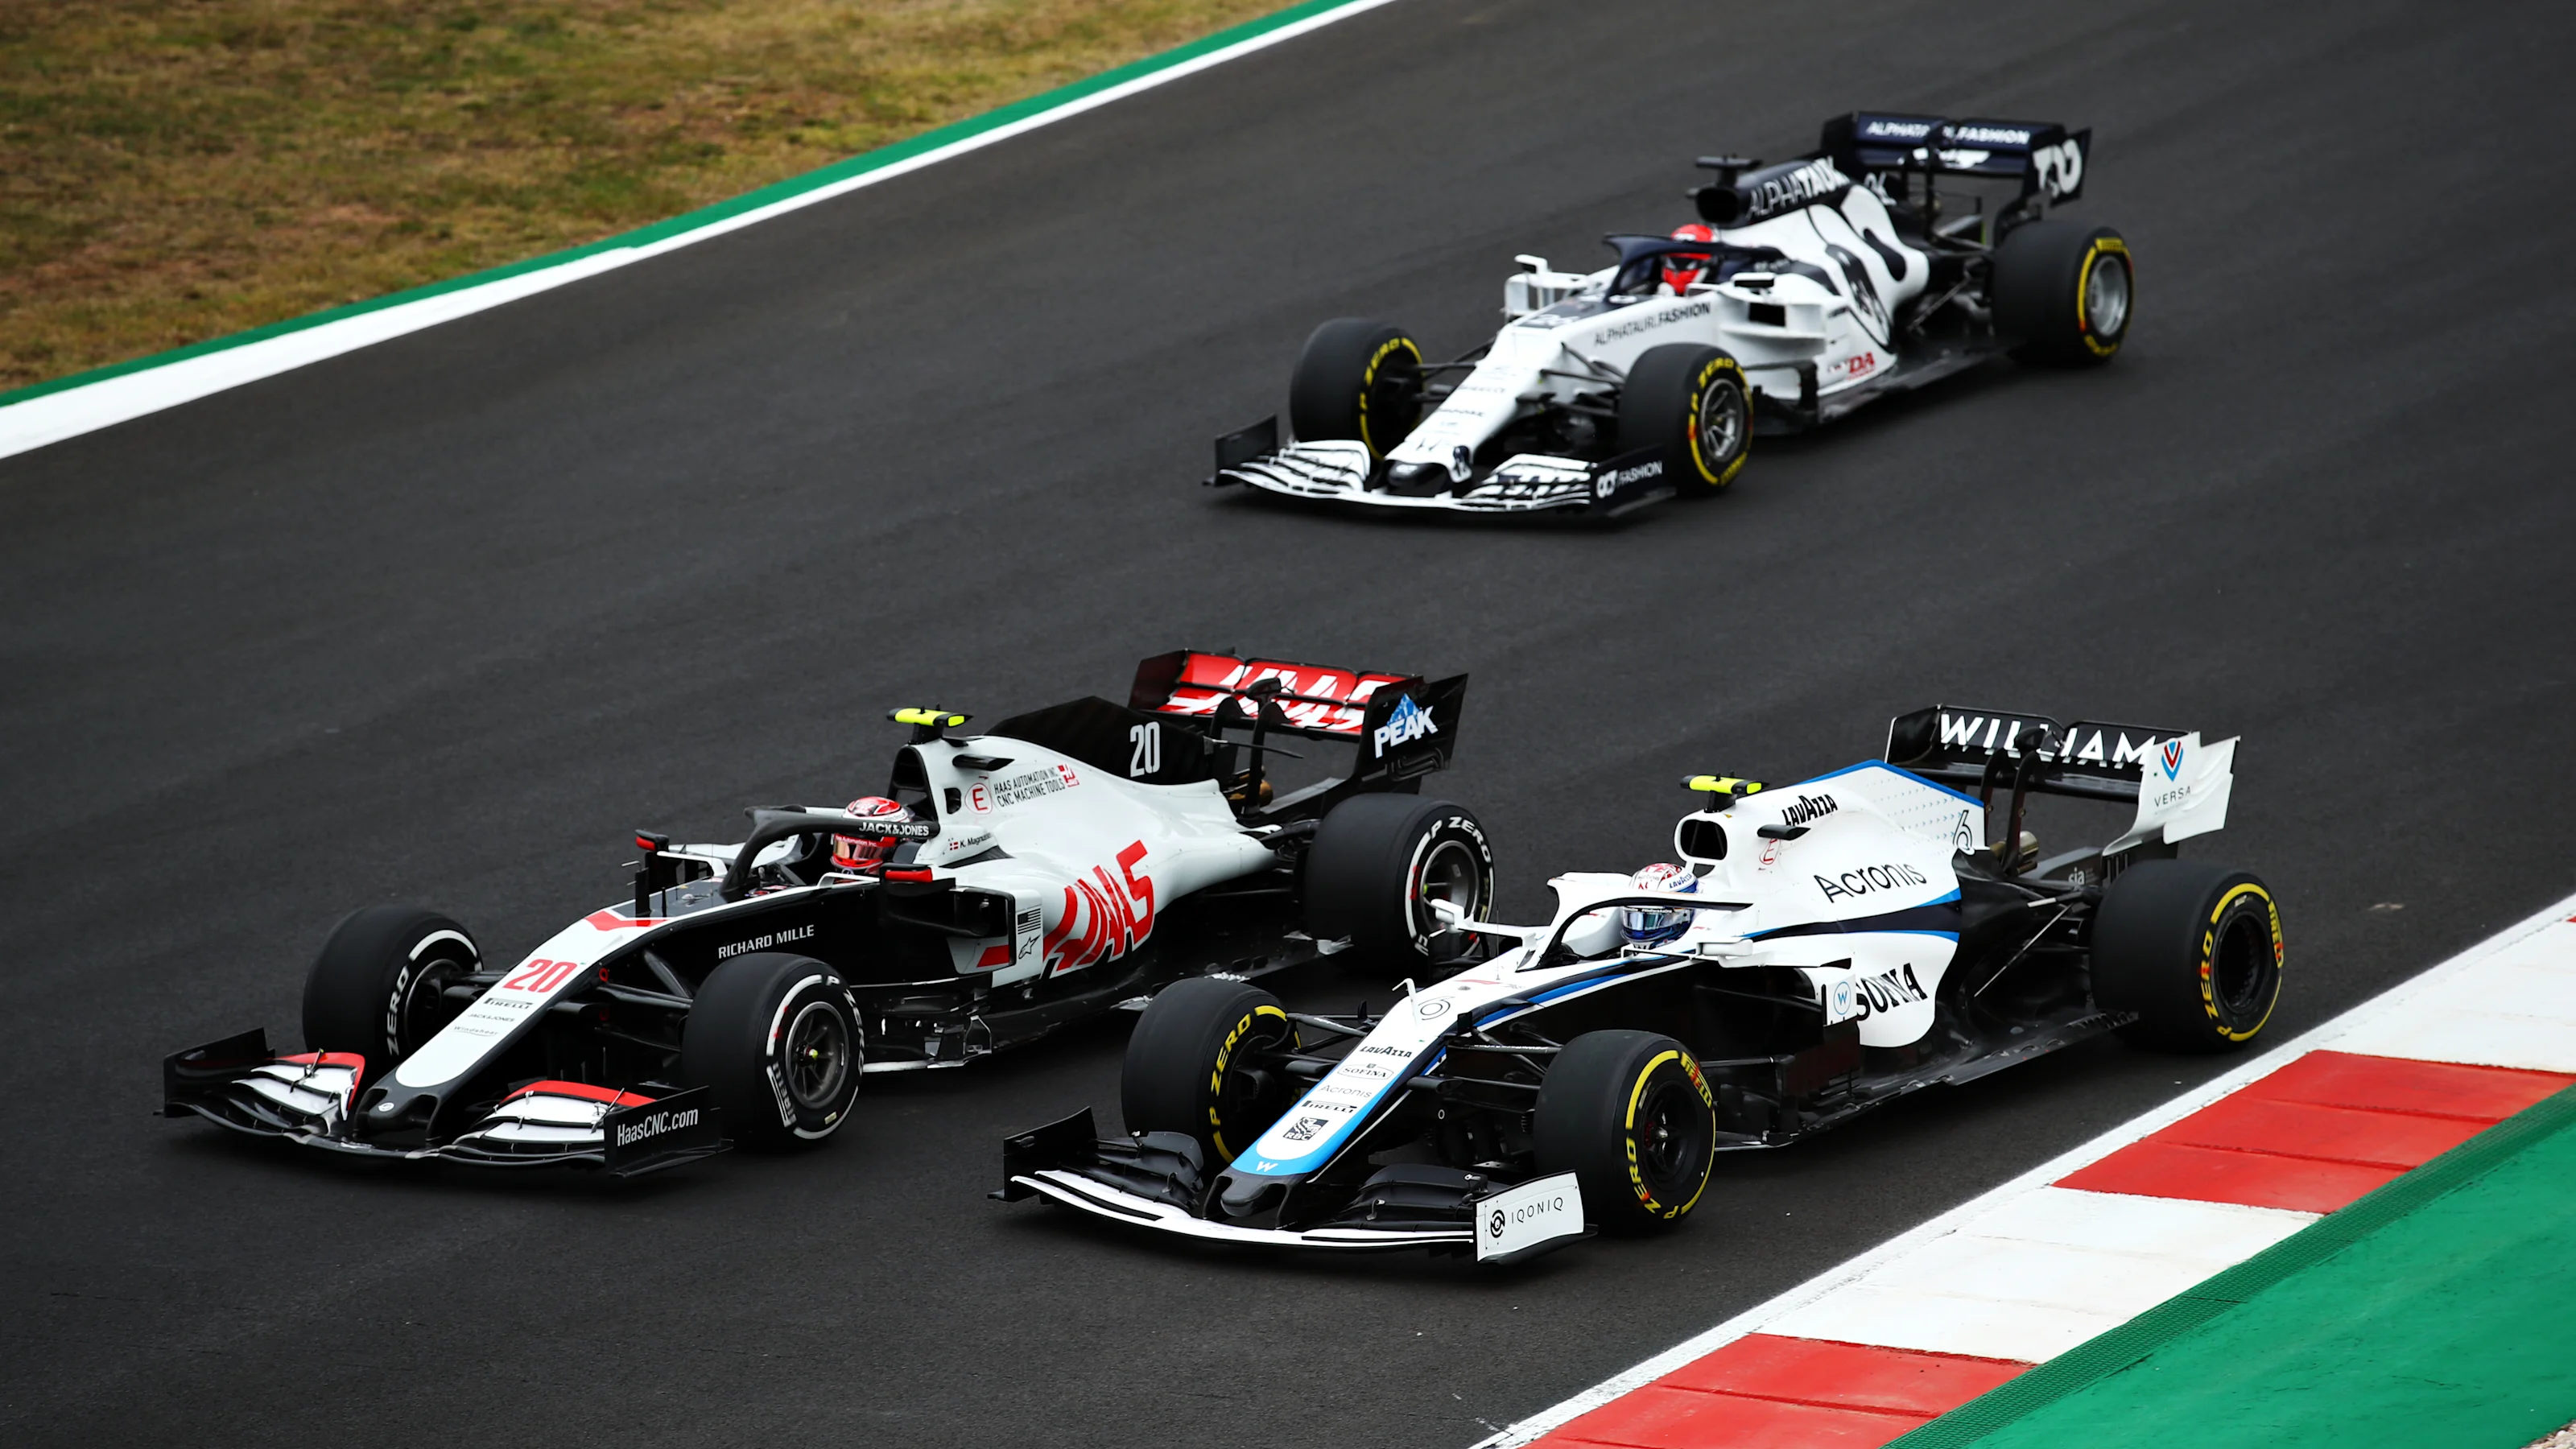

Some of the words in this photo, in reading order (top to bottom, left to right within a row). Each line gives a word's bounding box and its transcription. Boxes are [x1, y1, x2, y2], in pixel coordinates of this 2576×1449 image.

[1374, 705, 1439, 758] PEAK
[1129, 721, 1160, 777] 20
[993, 780, 1012, 795] HAAS
[1013, 770, 1049, 789] AUTOMATION
[997, 792, 1014, 807] CNC
[1013, 782, 1046, 803] MACHINE
[1045, 778, 1066, 794] TOOLS
[2154, 786, 2190, 807] VERSA
[859, 822, 930, 836] JACK&JONES
[1430, 819, 1443, 839] P
[1448, 816, 1492, 863] ZERO
[1953, 810, 1974, 855] 6
[1814, 864, 1927, 903] Acronis
[718, 935, 773, 959] RICHARD
[776, 924, 815, 944] MILLE
[502, 958, 577, 993] 20
[826, 975, 840, 986] P
[2201, 930, 2219, 1020] ZERO
[387, 965, 409, 1056] ZERO
[484, 997, 533, 1009] PIRELLI
[1211, 1013, 1251, 1097] ZERO
[1342, 1067, 1387, 1078] SOFINA
[1209, 1106, 1221, 1126] P
[1302, 1100, 1358, 1113] PIRELLI
[617, 1108, 699, 1147] HaasCNC.com
[1284, 1132, 1312, 1141] RBC
[1626, 1137, 1662, 1214] ZERO
[1511, 1197, 1563, 1224] IQONIQ
[1663, 1205, 1679, 1219] P
